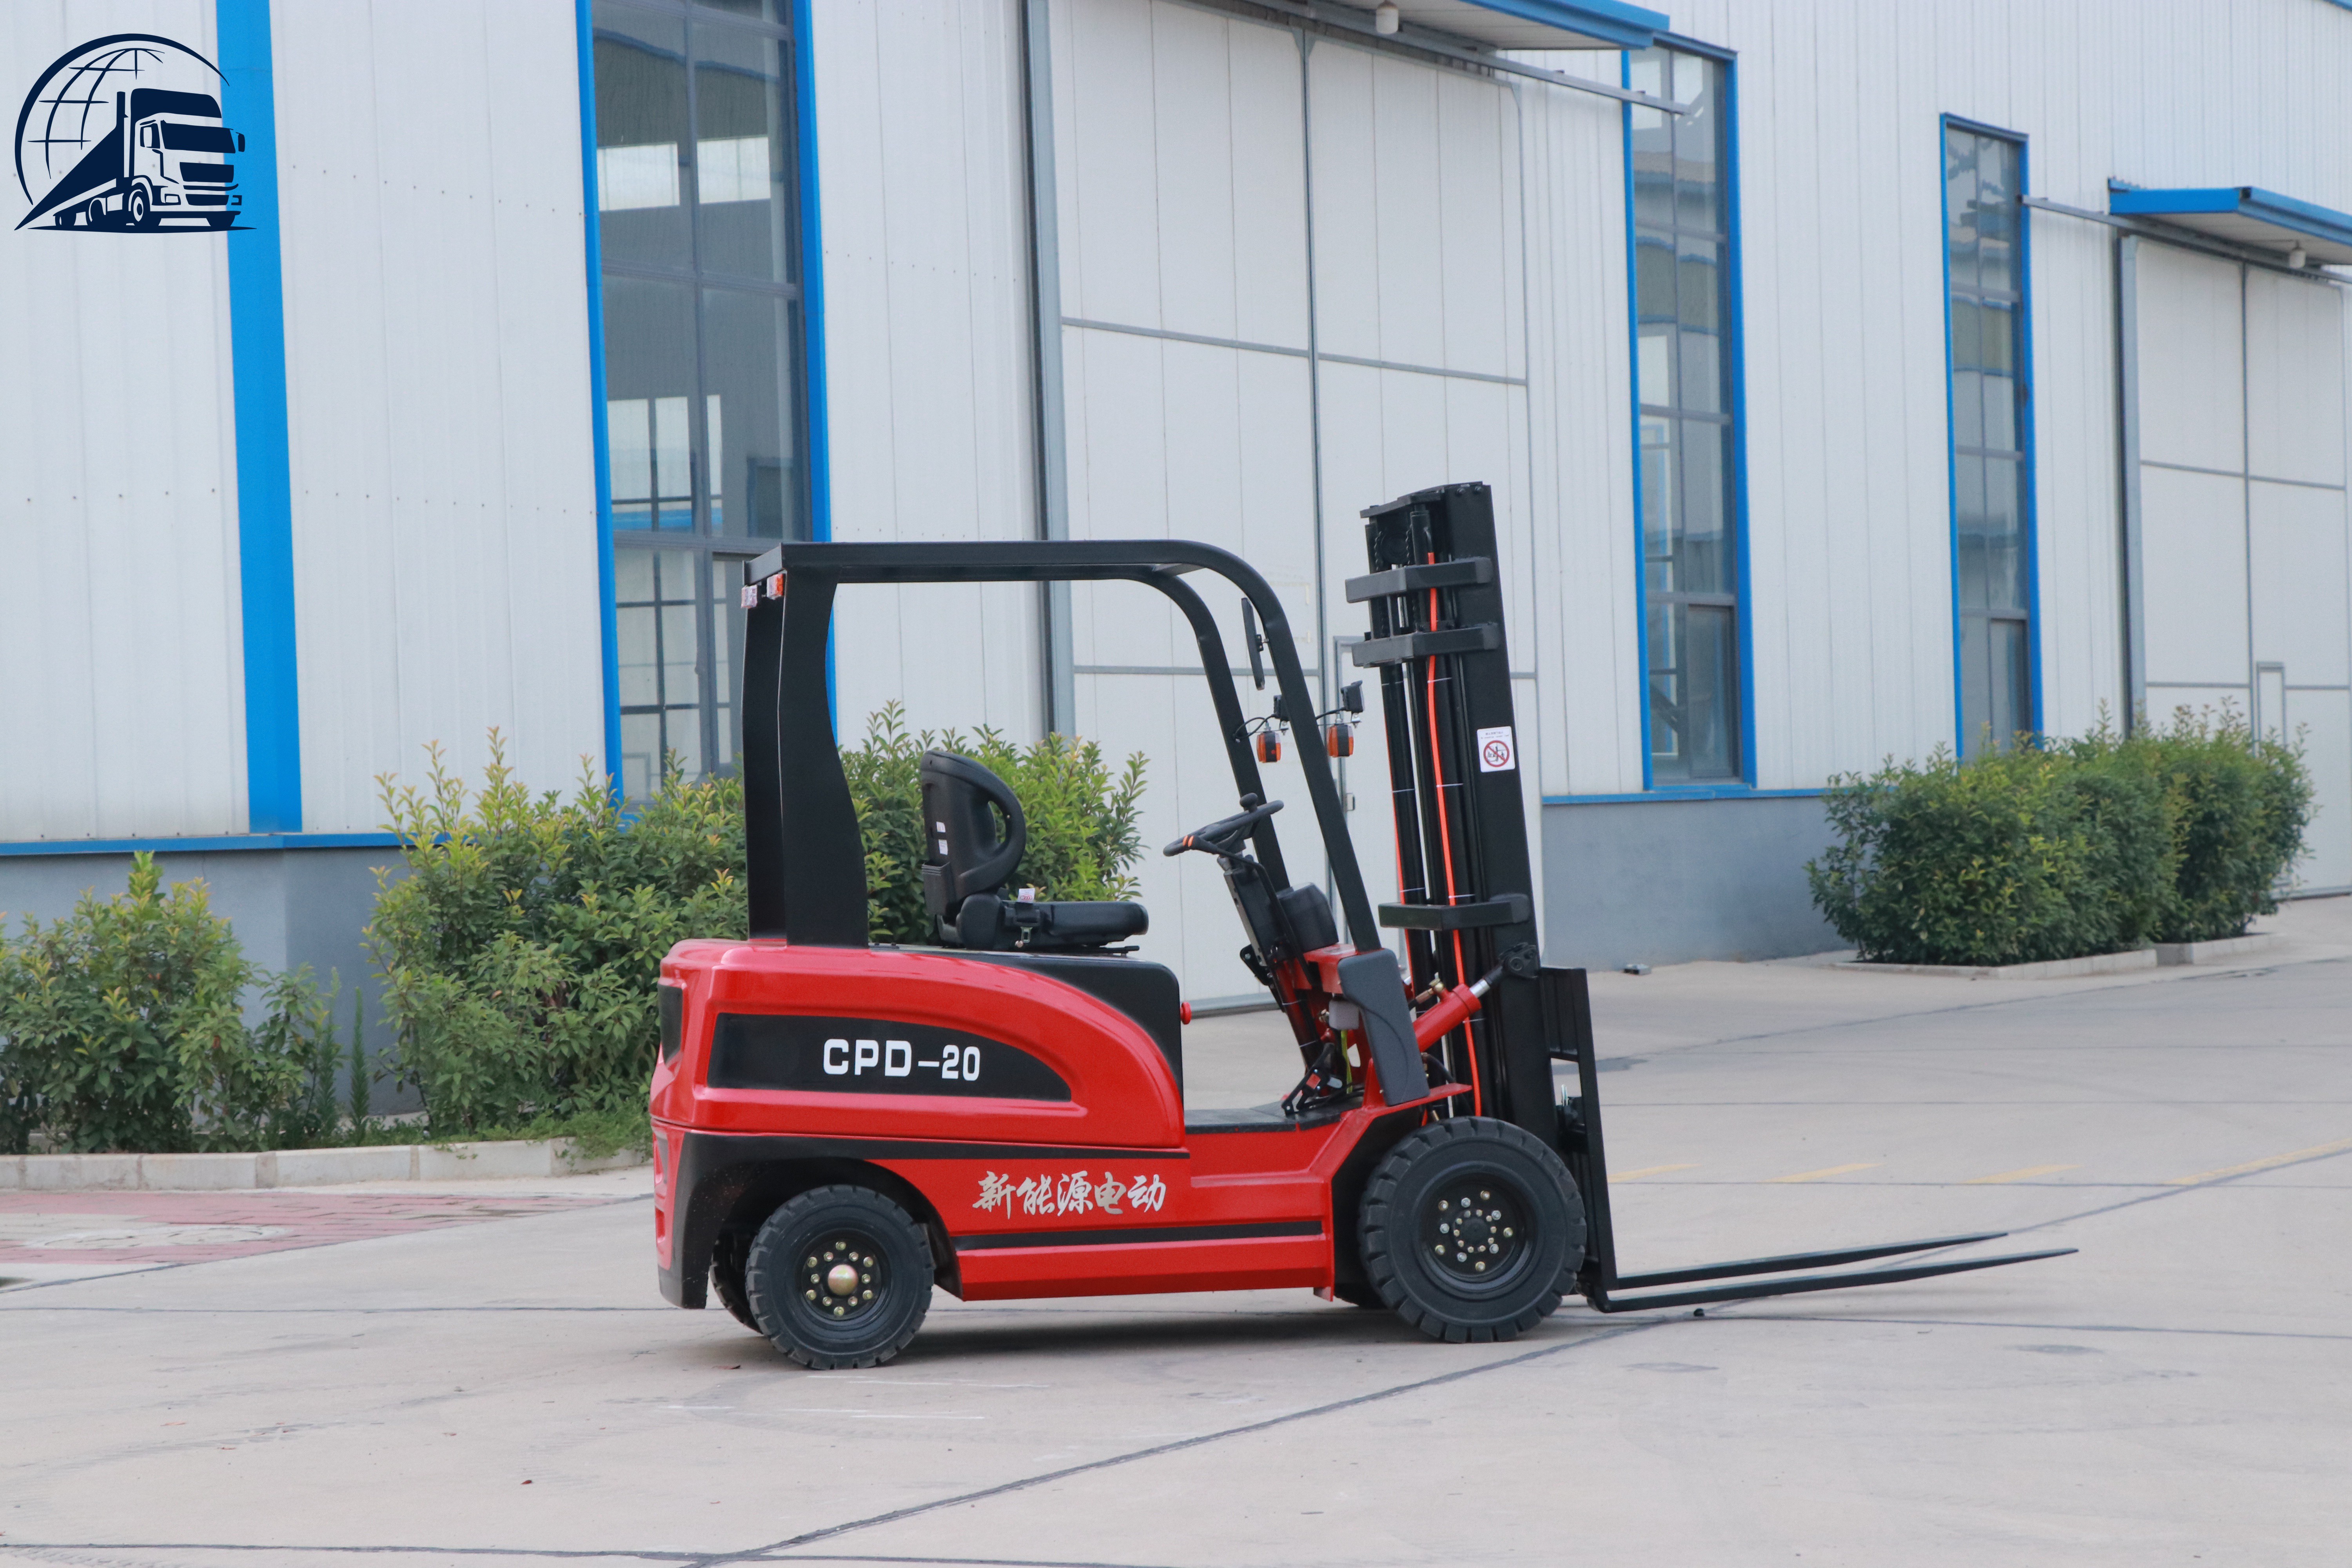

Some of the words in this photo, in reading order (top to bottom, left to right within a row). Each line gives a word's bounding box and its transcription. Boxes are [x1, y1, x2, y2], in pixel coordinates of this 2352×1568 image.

[823, 1038, 980, 1081] CPD-20
[972, 1170, 1167, 1220] 新能源电动
